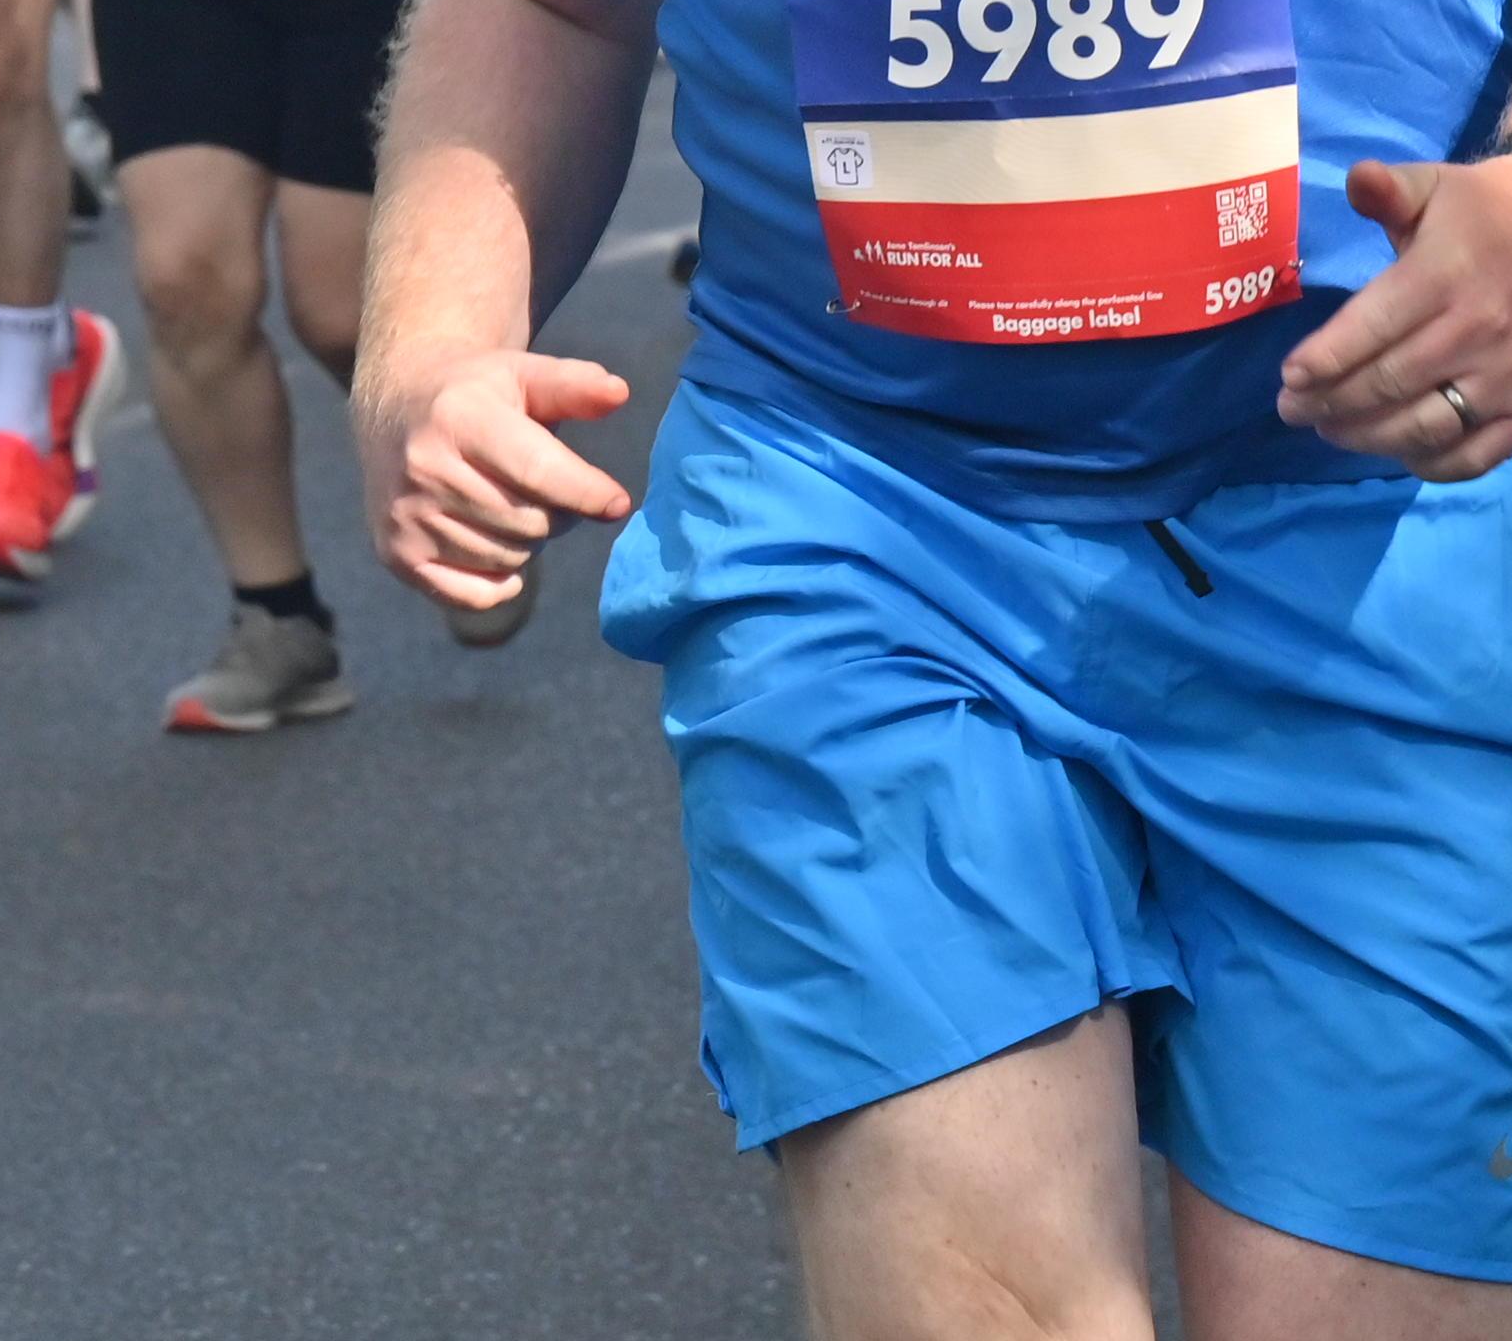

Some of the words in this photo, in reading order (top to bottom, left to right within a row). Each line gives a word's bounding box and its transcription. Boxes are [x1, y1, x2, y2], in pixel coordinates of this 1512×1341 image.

[843, 161, 851, 174] L
[887, 251, 919, 266] RUN
[921, 253, 951, 267] FOR
[955, 253, 983, 268] ALL
[1205, 265, 1275, 315] 5989
[992, 313, 1083, 337] Baggage
[1089, 305, 1141, 329] label
